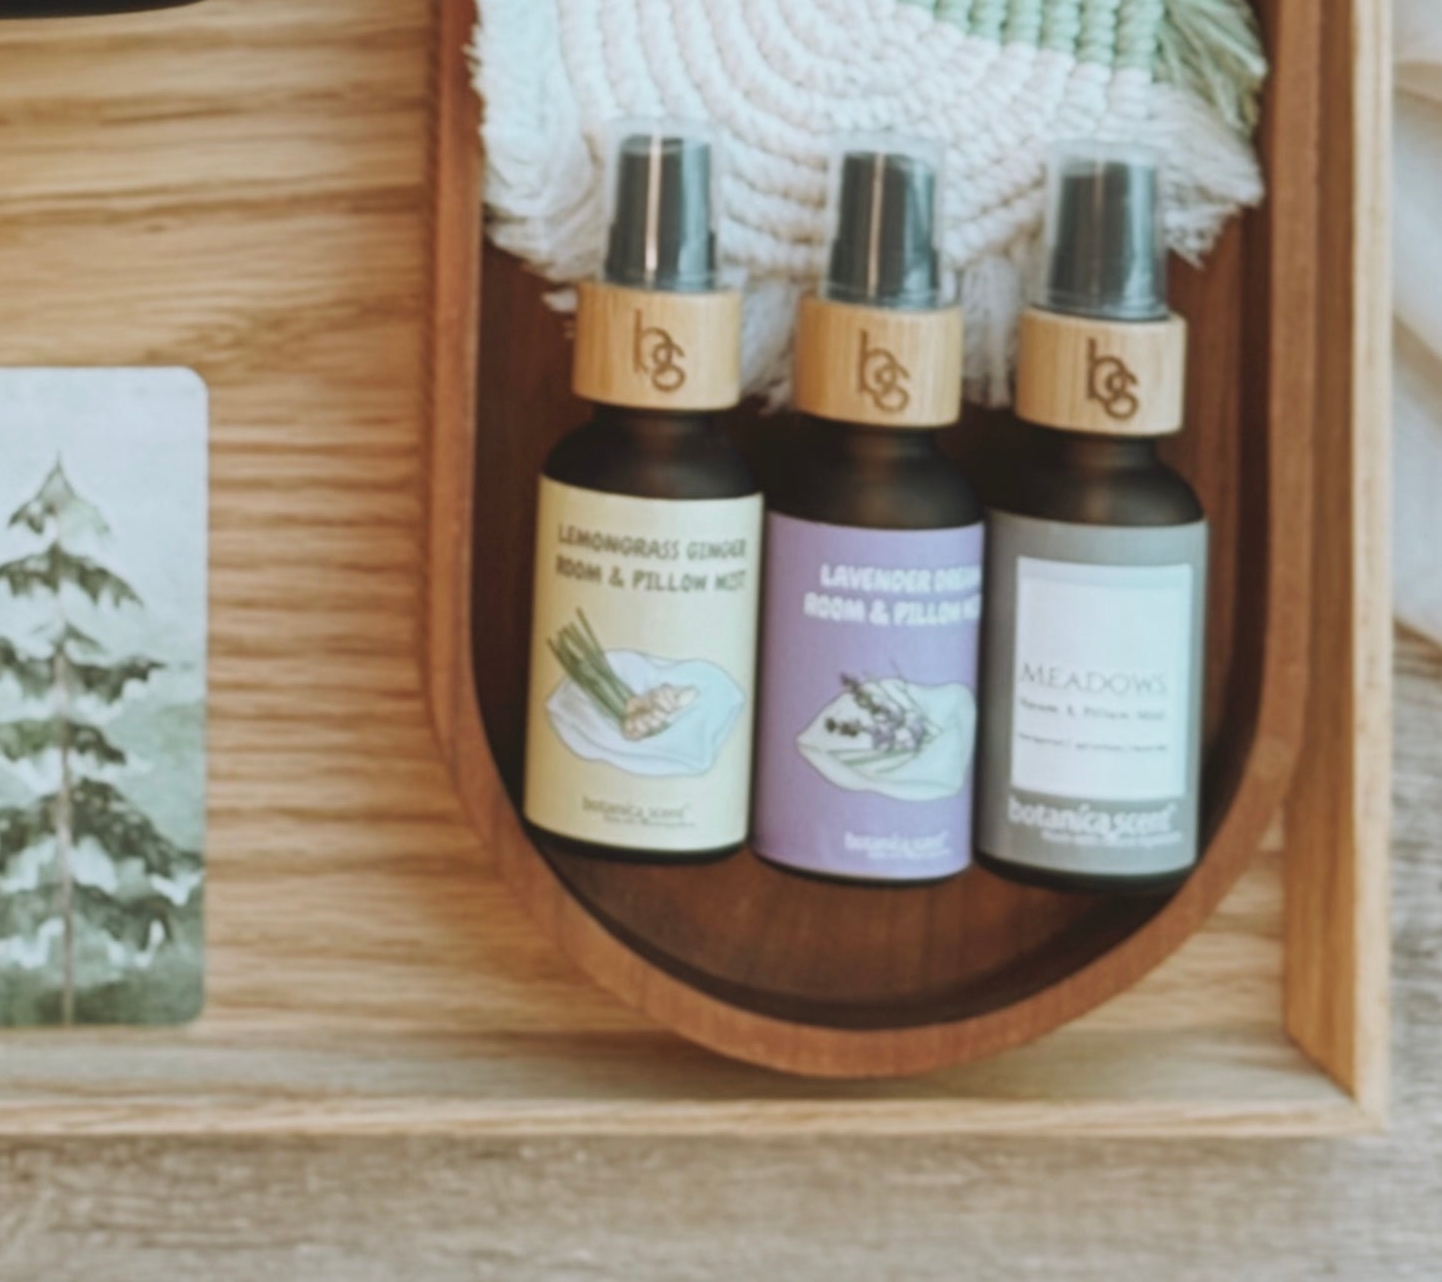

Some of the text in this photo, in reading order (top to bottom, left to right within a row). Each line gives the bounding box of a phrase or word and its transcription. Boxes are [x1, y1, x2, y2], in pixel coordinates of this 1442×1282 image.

[559, 524, 681, 561] LEMONGRASS
[555, 553, 603, 583] ROOM
[609, 566, 625, 589] &
[632, 568, 708, 592] PILLOW
[820, 563, 932, 593] LAVENDER
[803, 591, 865, 623] ROOM
[868, 598, 890, 626] &
[1021, 661, 1167, 695] MEADOWS
